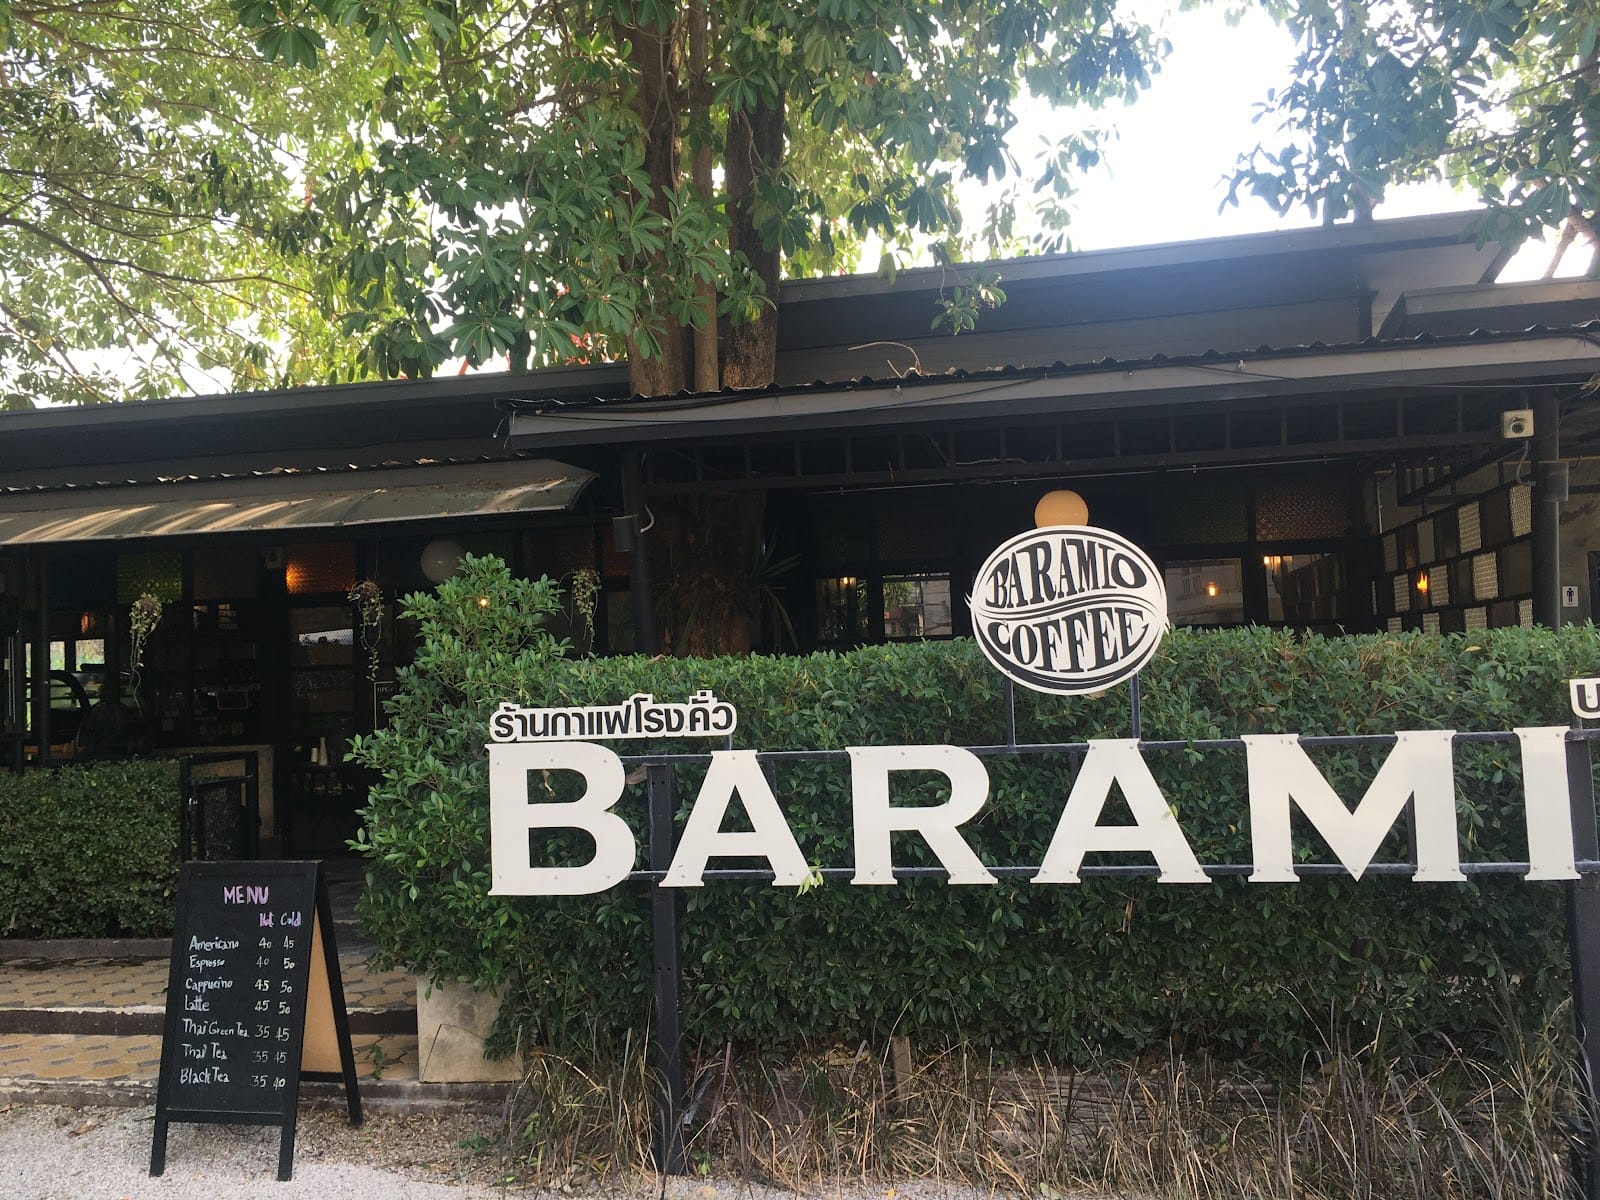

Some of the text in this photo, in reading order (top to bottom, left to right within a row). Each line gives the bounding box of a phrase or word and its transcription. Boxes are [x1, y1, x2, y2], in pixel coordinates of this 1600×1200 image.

[985, 538, 1147, 609] BARAMIO
[987, 607, 1149, 673] COFFEE
[494, 691, 733, 738] ร้านกาแฟโรงคั่ว
[485, 726, 1581, 896] BARAMI
[223, 886, 269, 905] MENU
[280, 911, 302, 927] Cold
[189, 936, 295, 952] Americano 40 45
[189, 954, 295, 973] Espresso 40 50
[255, 979, 270, 991] 45
[280, 980, 293, 993] 50
[184, 995, 291, 1015] Latte 45 50
[182, 1018, 290, 1042] Thai Green Tea 35 45
[181, 1043, 207, 1059] Thai
[211, 1042, 228, 1060] Tea
[252, 1051, 269, 1063] 35
[180, 1067, 286, 1091] Black Tea 35 40
